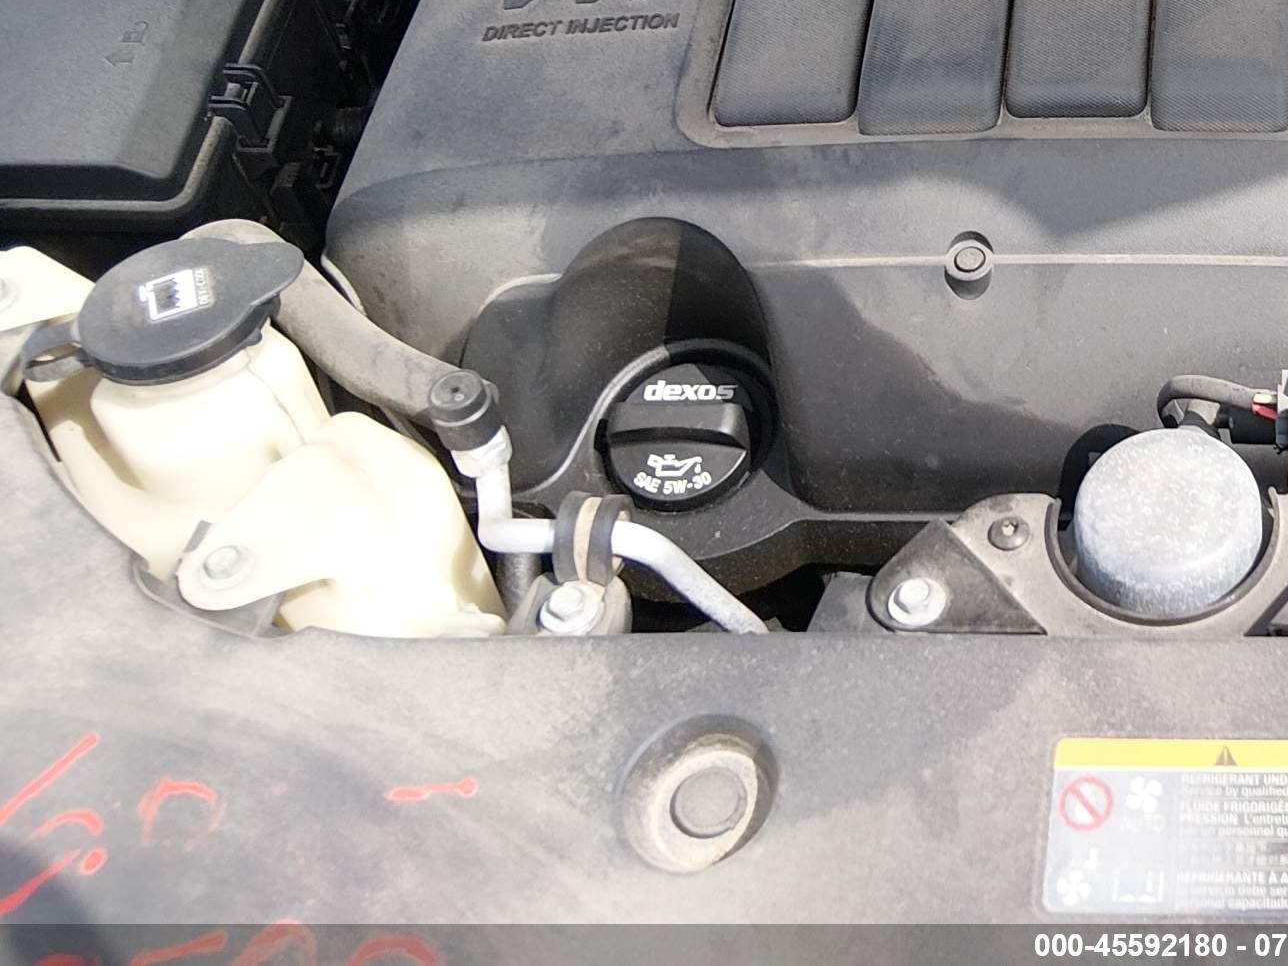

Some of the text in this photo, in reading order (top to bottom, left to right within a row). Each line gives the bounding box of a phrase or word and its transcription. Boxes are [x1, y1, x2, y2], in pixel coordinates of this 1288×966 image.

[482, 11, 681, 42] DIRECT INJECTION
[643, 380, 738, 402] dexos
[633, 471, 712, 495] SAE 5W-30
[1225, 786, 1240, 798] by
[1217, 825, 1274, 838] personnel
